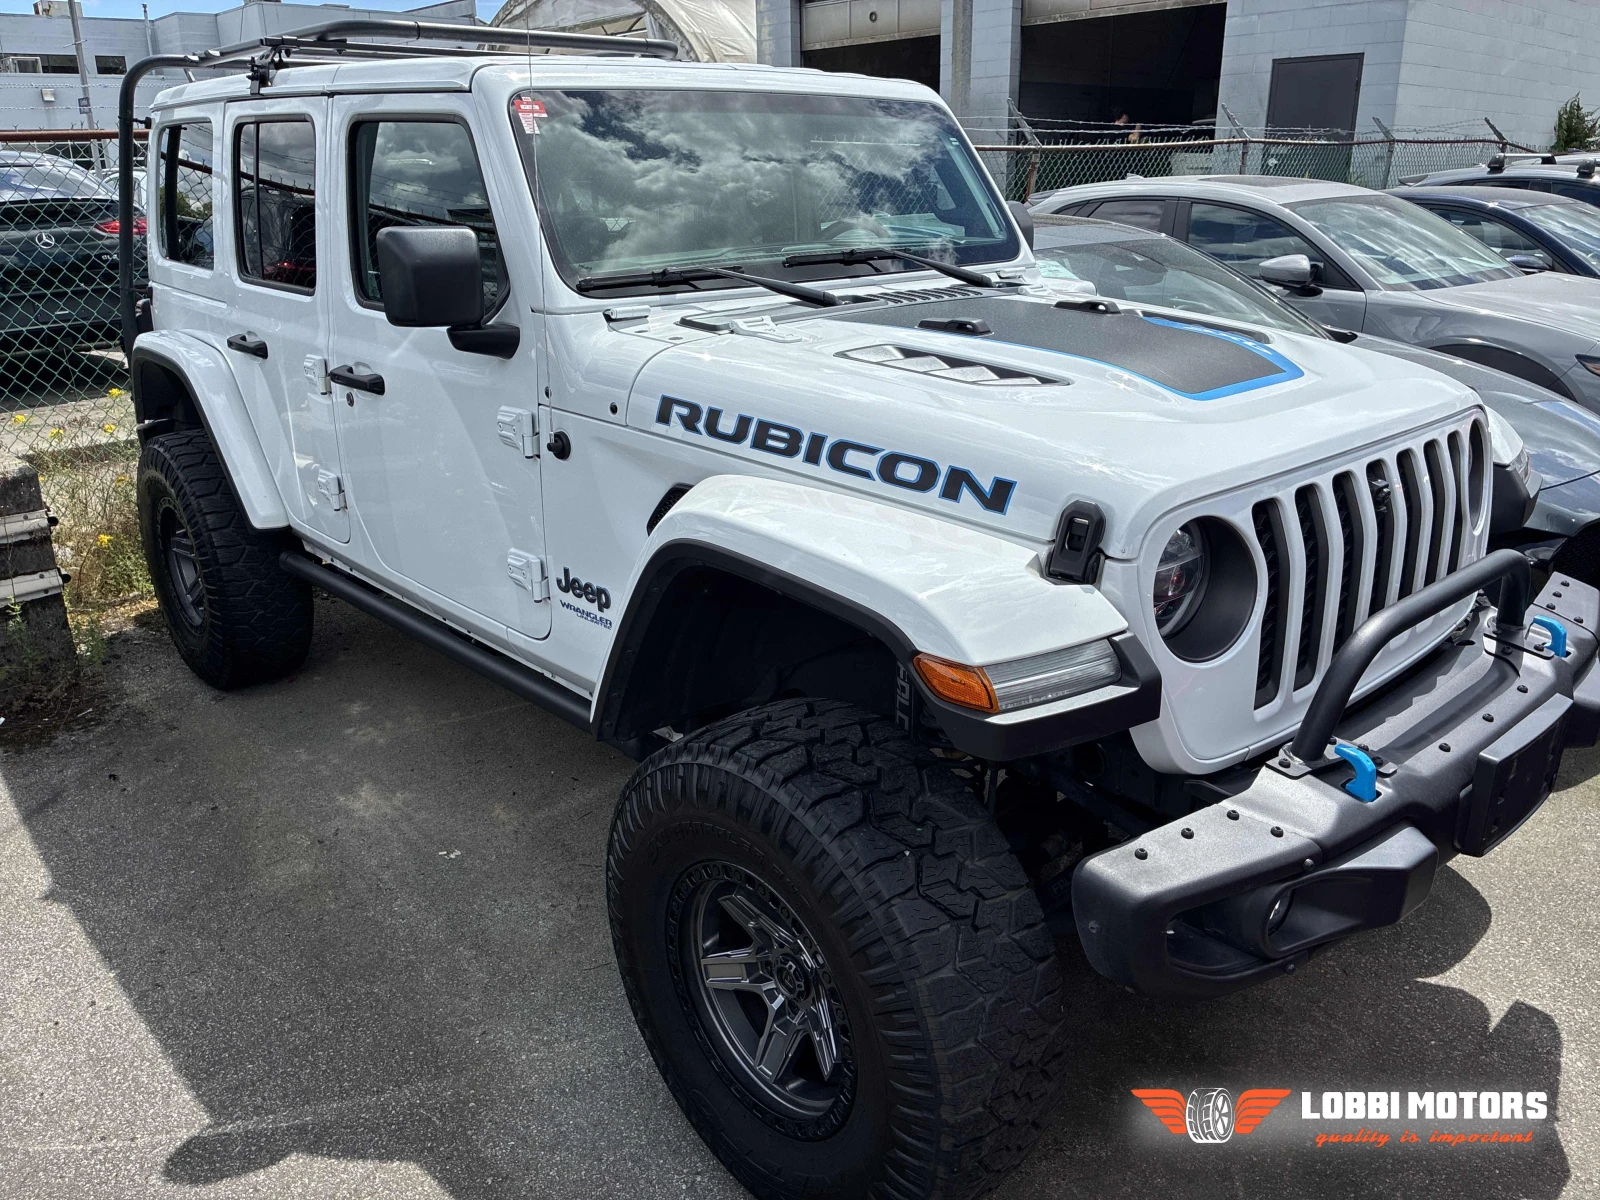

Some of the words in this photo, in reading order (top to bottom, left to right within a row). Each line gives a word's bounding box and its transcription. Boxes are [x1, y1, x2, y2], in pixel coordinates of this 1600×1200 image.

[655, 394, 1018, 515] RUBICON
[556, 566, 612, 613] Jeep
[559, 599, 613, 627] WRANGLER
